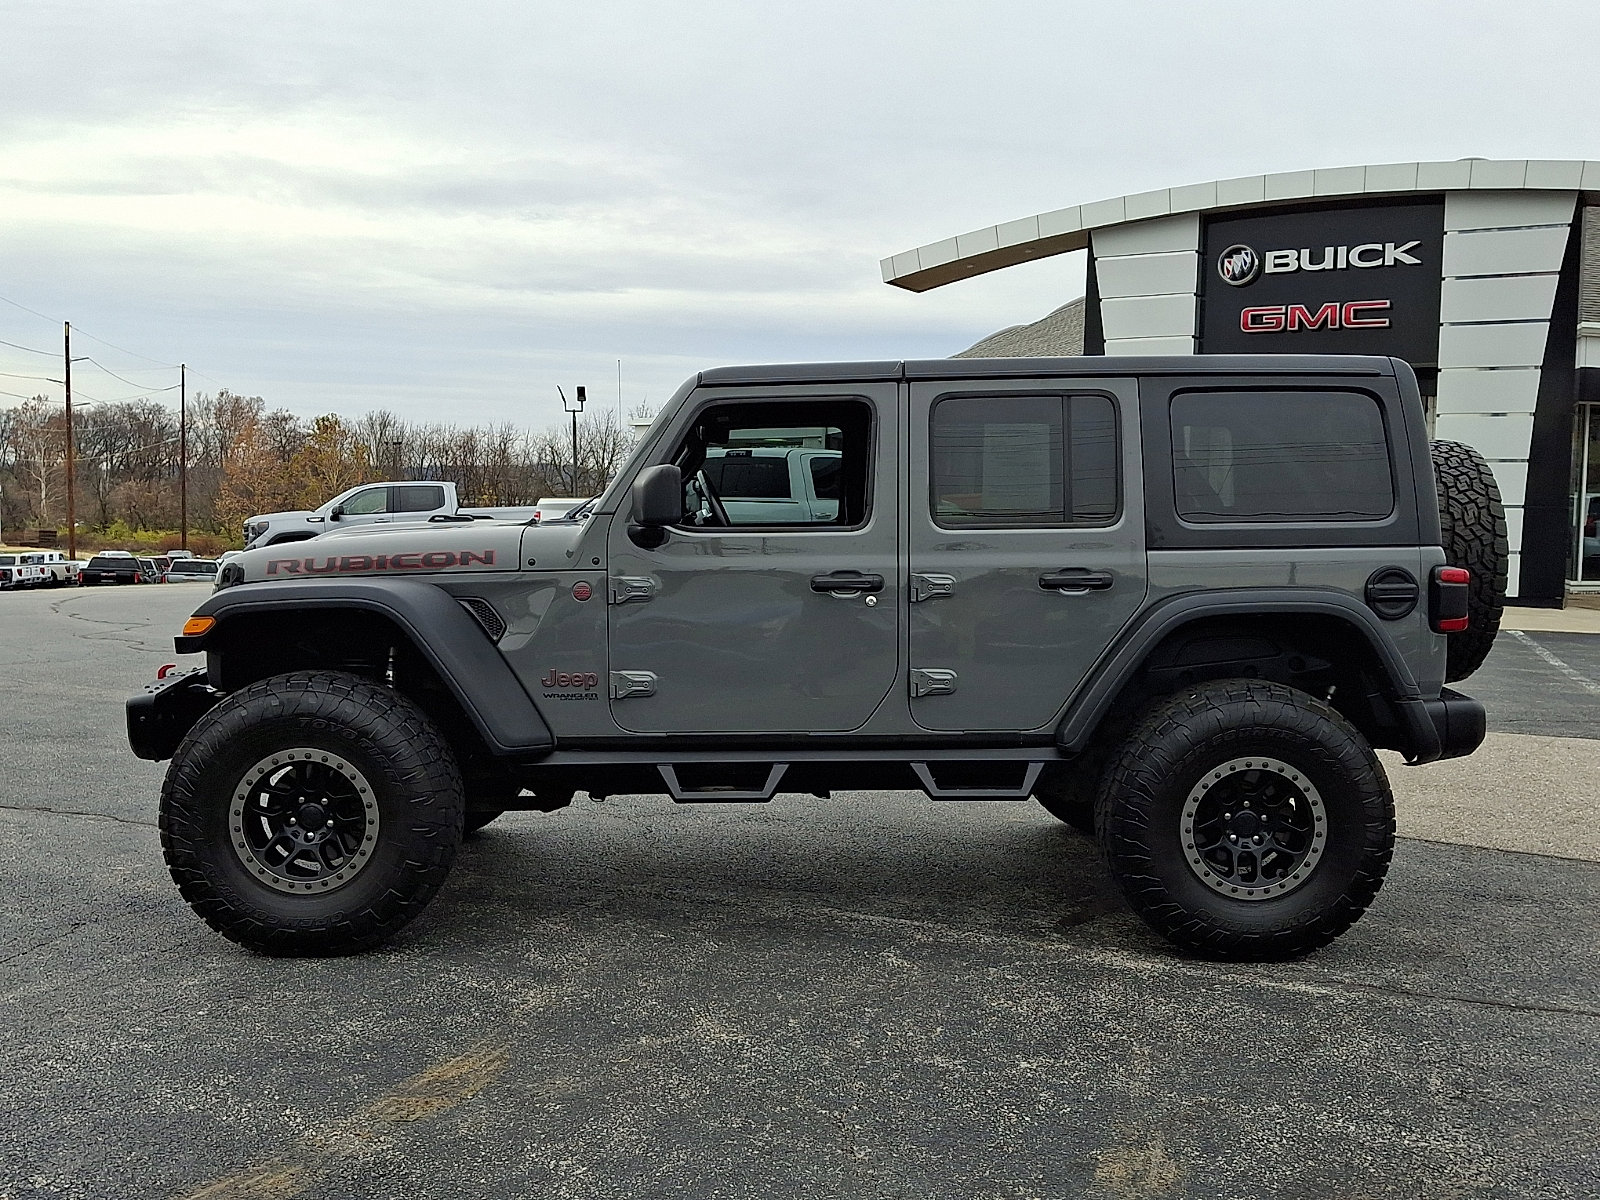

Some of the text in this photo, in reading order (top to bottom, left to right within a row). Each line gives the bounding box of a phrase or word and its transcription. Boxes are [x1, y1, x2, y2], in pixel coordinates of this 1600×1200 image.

[1265, 240, 1422, 274] BUICK
[1240, 300, 1391, 333] GMC
[266, 550, 496, 574] RUBICON
[541, 668, 599, 690] Jeep
